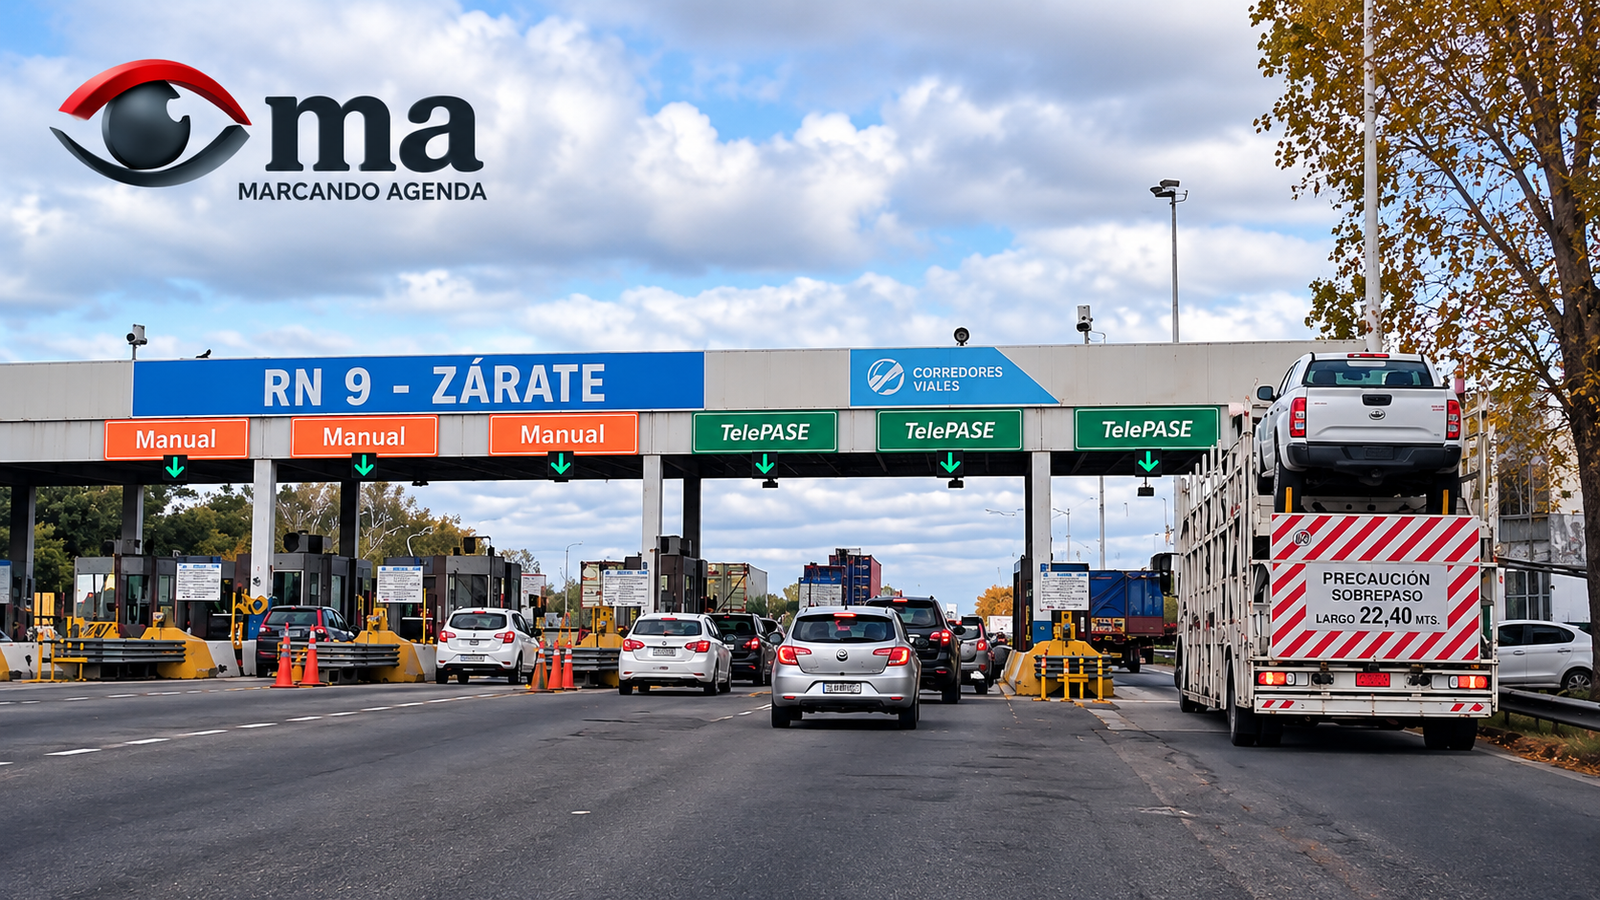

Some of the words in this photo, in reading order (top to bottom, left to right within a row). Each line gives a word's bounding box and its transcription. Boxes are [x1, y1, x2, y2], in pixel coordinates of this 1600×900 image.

[264, 367, 322, 407] RN
[345, 367, 371, 406] 9
[393, 385, 410, 394] -
[432, 357, 606, 404] ZÁRATE
[912, 366, 1003, 379] CORREDORES
[913, 380, 960, 392] VIALES
[323, 426, 405, 447] Manual
[521, 423, 605, 444] Manual
[720, 423, 811, 442] TelePASE
[905, 421, 996, 440] TelePASE
[1102, 420, 1193, 438] TelePASE
[136, 429, 216, 449] Manual
[1323, 570, 1430, 586] PRECAUCIÓN
[1331, 588, 1423, 602] SOBREPASO
[1316, 614, 1355, 624] LARGO
[1359, 606, 1412, 627] 22,40
[1415, 615, 1440, 625] MTS.
